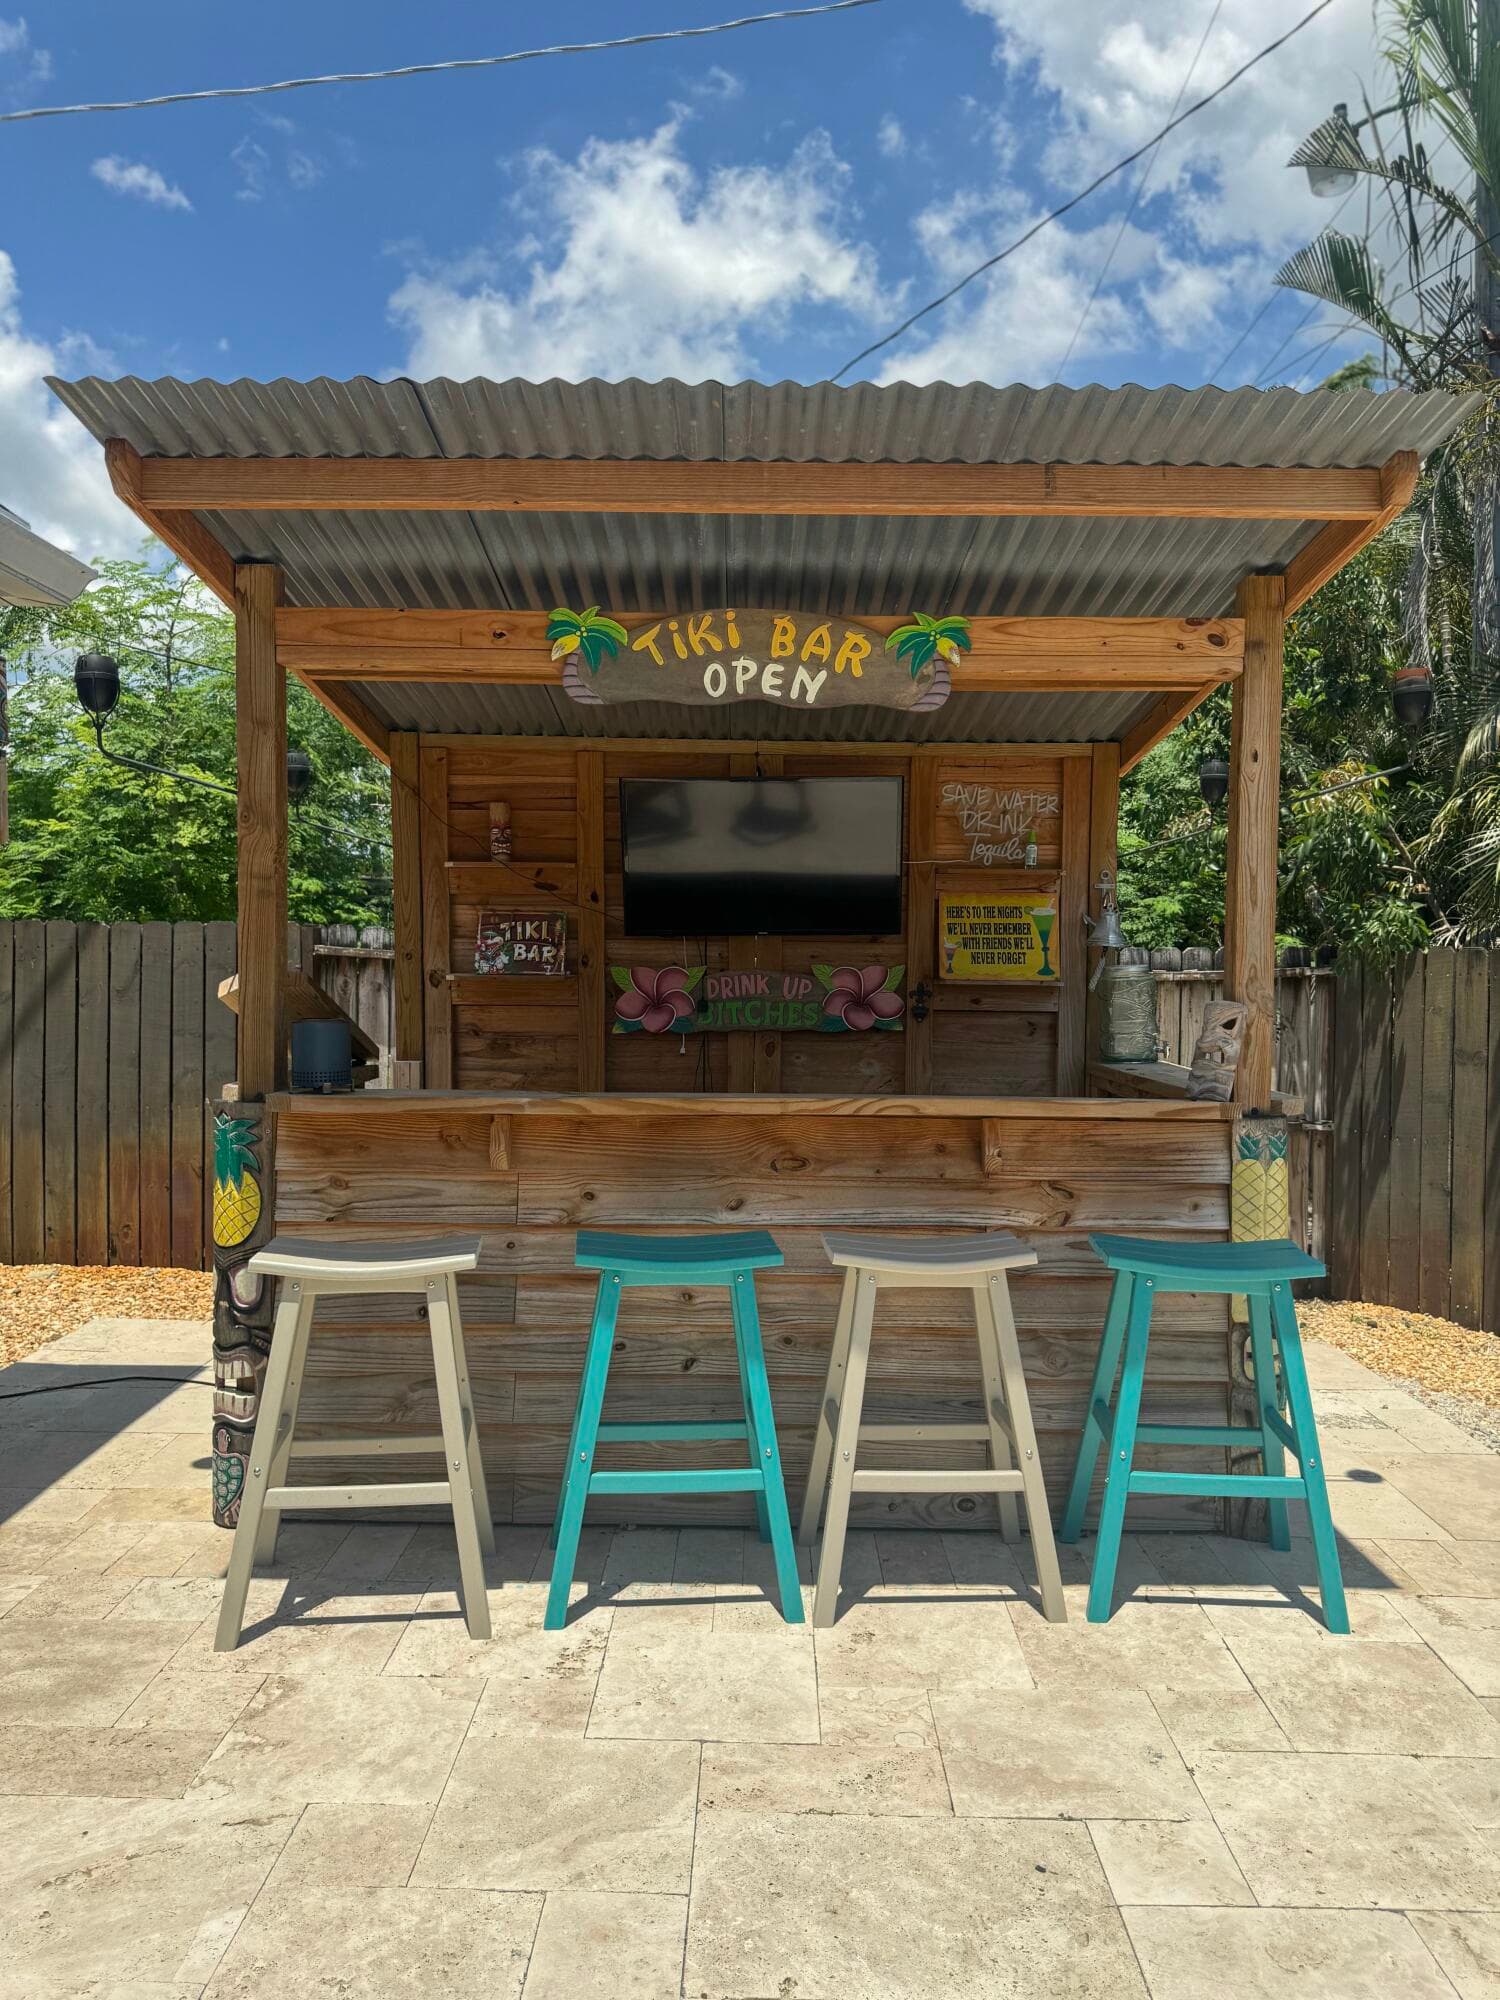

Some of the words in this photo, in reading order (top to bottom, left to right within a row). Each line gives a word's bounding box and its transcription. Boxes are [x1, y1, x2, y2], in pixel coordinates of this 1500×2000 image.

[771, 615, 872, 678] BAR
[703, 656, 828, 705] OPEN
[942, 784, 990, 805] SAVE
[995, 791, 1059, 814] WATER
[960, 810, 1034, 835] DRINK
[946, 906, 971, 919] HERE'S
[972, 906, 981, 919] TO
[982, 906, 996, 919] THE
[997, 906, 1023, 919] NIGHTS
[500, 920, 549, 941] TIKI
[947, 922, 968, 935] WE'LL
[969, 922, 992, 935] NEVER
[993, 922, 1032, 935] REMEMBER
[513, 943, 557, 962] BAR
[962, 937, 981, 950] WITH
[982, 937, 1013, 950] FRIENDS
[1014, 937, 1035, 950] WE'LL
[971, 951, 996, 965] NEVER
[997, 951, 1027, 965] FORGET
[706, 975, 770, 999] DRINK
[783, 976, 813, 999] UP
